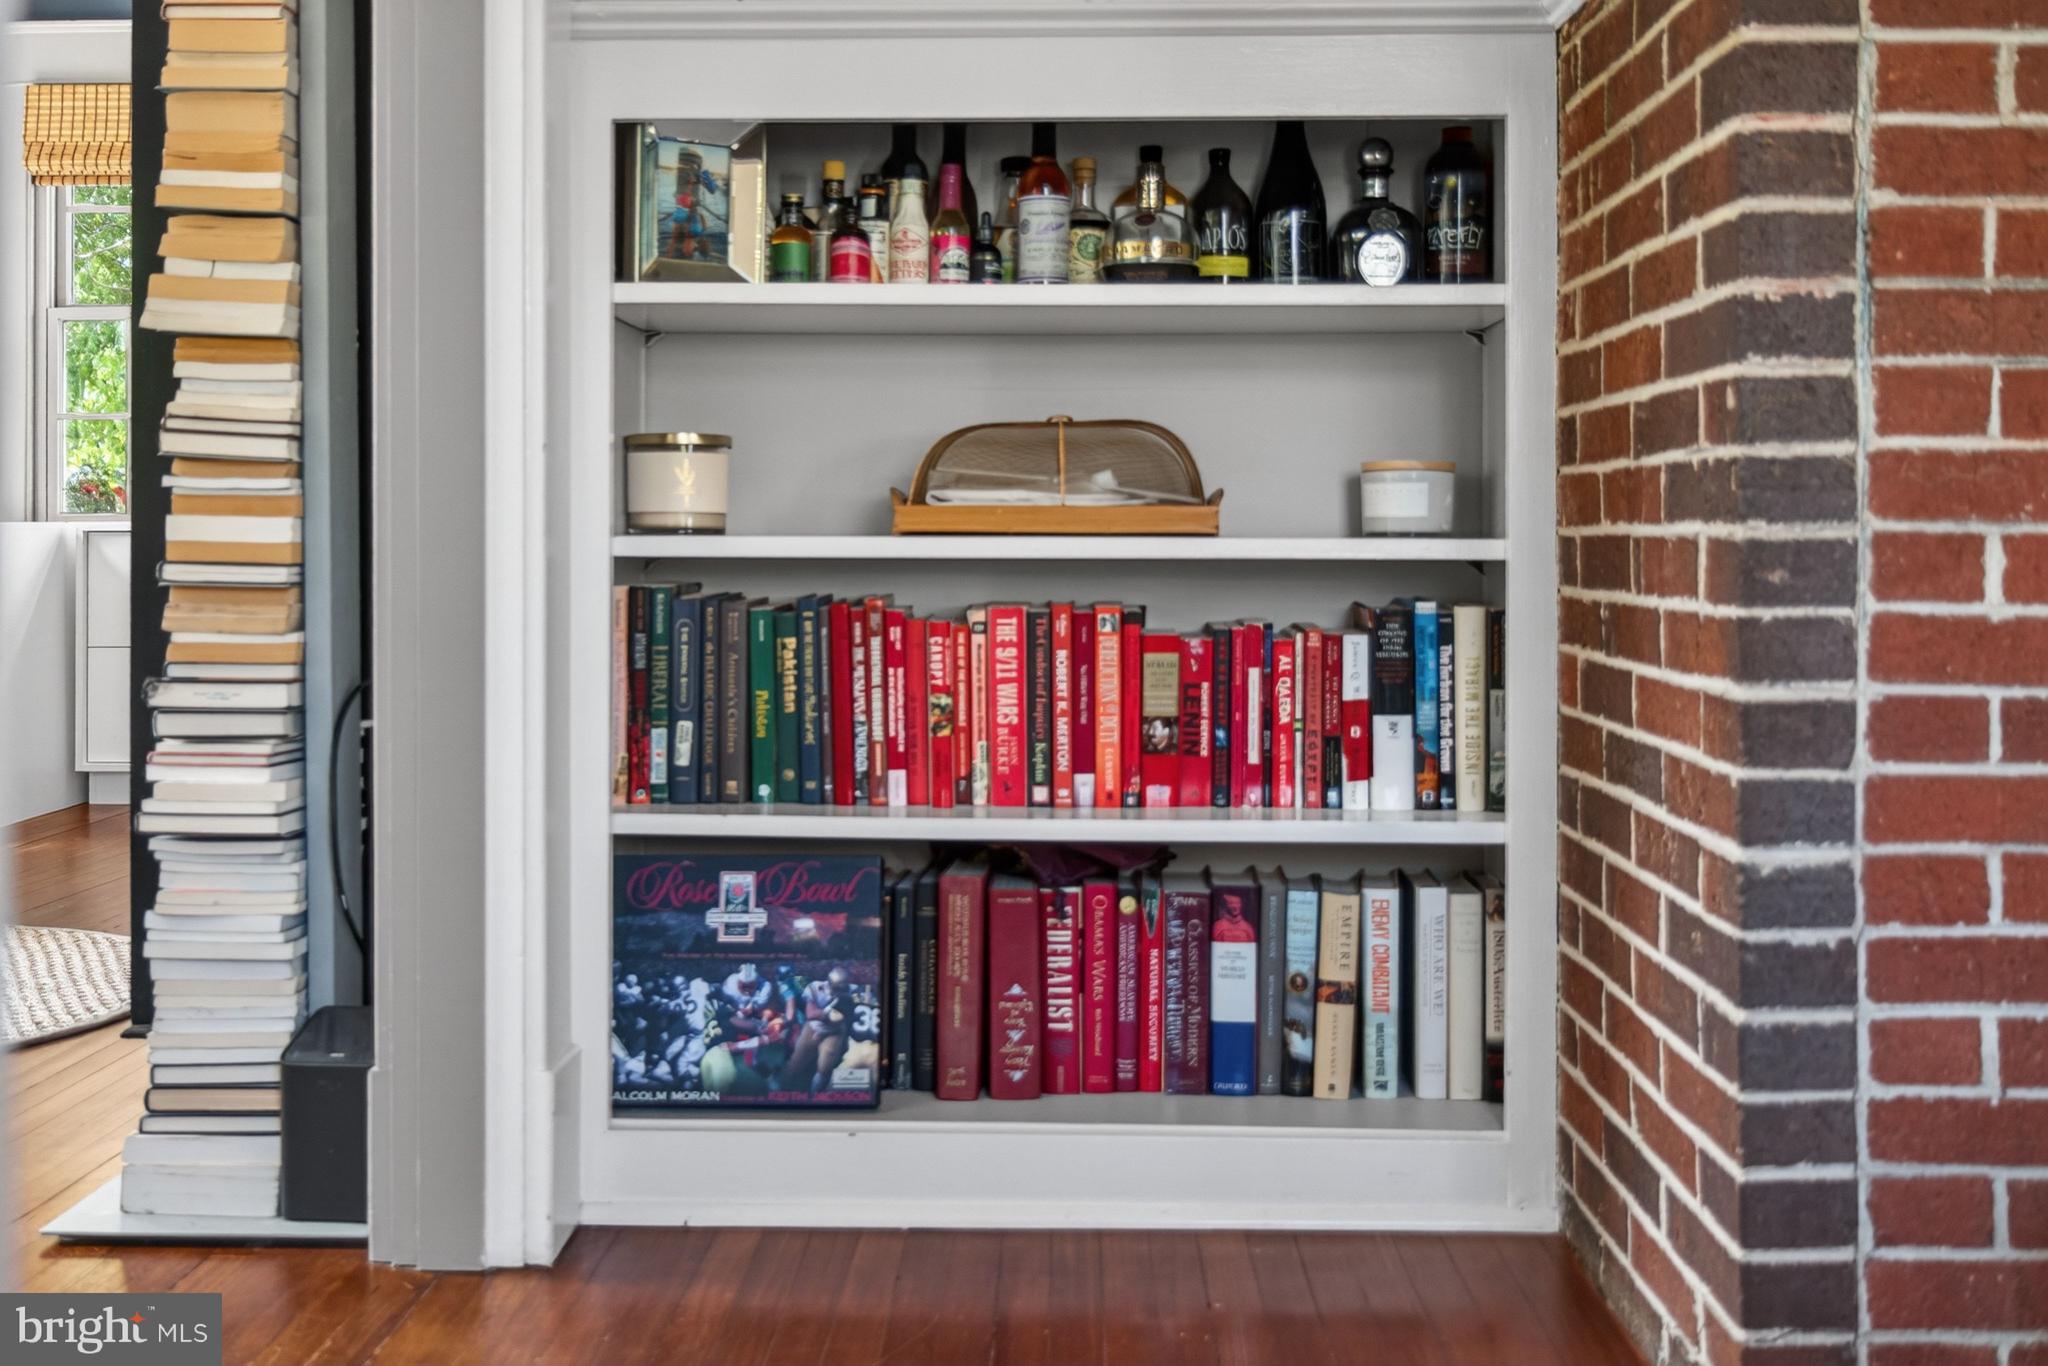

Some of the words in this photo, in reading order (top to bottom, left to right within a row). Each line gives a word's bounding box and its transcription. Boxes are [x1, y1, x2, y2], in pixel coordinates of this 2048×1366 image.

[996, 617, 1018, 642] THE
[1036, 618, 1047, 637] The
[782, 636, 798, 713] Pakistan
[930, 636, 943, 685] CANOPY
[996, 647, 1018, 679] 9/11
[1056, 650, 1068, 697] ROBERT
[1279, 655, 1291, 672] AL
[1440, 645, 1453, 663] The
[704, 656, 714, 698] ISLAMIC
[1440, 664, 1453, 701] Turban
[1464, 656, 1480, 701] MIRAGE
[996, 682, 1018, 724] WARS
[1033, 697, 1047, 738] Inquiry
[1056, 701, 1068, 713] K.
[1183, 683, 1200, 756] LENIN
[1276, 676, 1291, 724] QAEDA
[1440, 702, 1453, 716] for
[1464, 707, 1480, 728] THE
[704, 701, 714, 765] CHALLENGE
[1056, 717, 1068, 771] MERTON
[1440, 717, 1453, 737] the
[997, 727, 1009, 774] BURKE
[1034, 742, 1048, 782] Kaplan
[1307, 729, 1318, 783] EGYPT
[1440, 738, 1453, 773] Crown
[1464, 735, 1480, 775] INSIDE
[626, 861, 718, 910] Rose
[754, 860, 880, 905] Bowl
[1338, 904, 1352, 972] EMPIRE
[1371, 899, 1390, 938] ENEMY
[1433, 914, 1444, 951] WHO
[1119, 922, 1127, 972] AMERICAN
[1128, 922, 1136, 976] AMERICAN
[1187, 919, 1201, 984] CLASSICS
[1091, 960, 1107, 1000] WARS
[1148, 948, 1158, 1001] NATURAL
[1371, 944, 1390, 1014] COMBATANT
[1433, 955, 1444, 982] ARE
[1187, 986, 1201, 1002] OF
[1433, 988, 1444, 1017] WE?
[1492, 963, 1504, 1031] Austerlitz
[1148, 1005, 1158, 1060] SECURITY
[1187, 1004, 1201, 1066] MODERN
[612, 1090, 667, 1101] ALCOLM
[671, 1090, 720, 1101] MORAN
